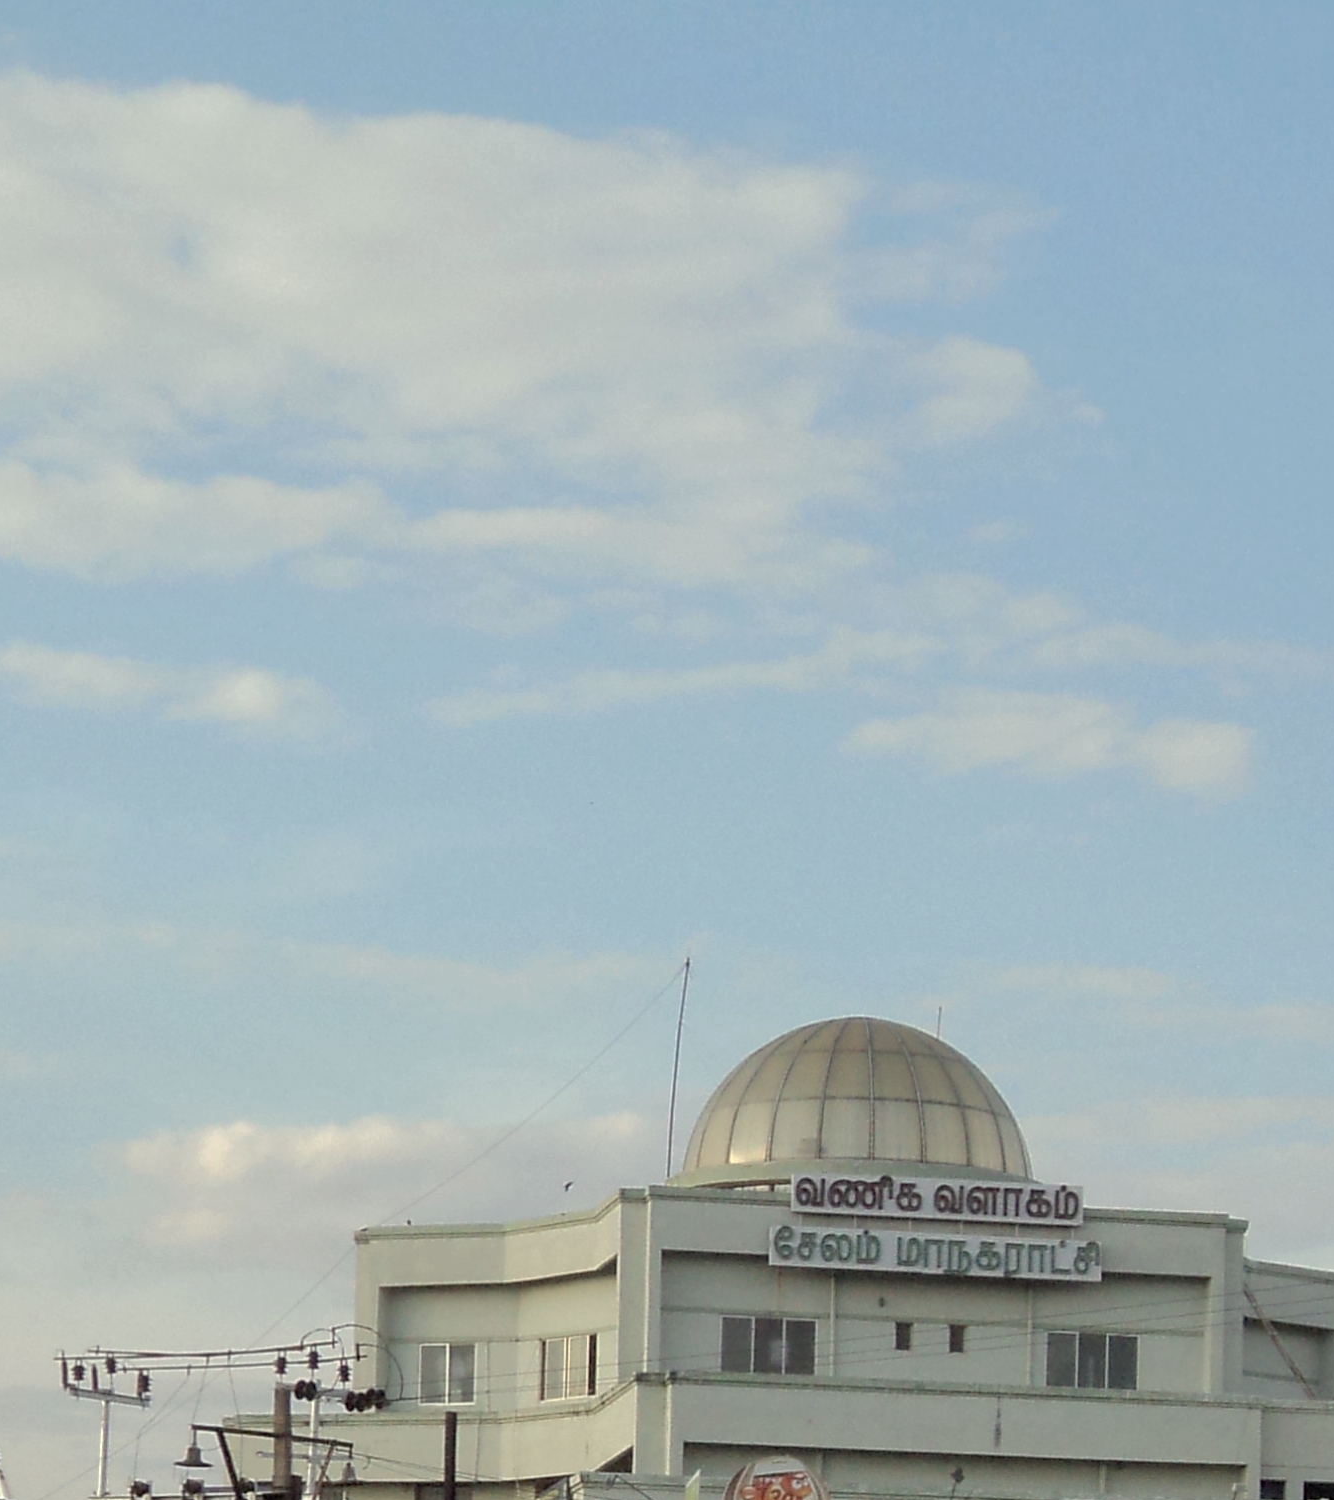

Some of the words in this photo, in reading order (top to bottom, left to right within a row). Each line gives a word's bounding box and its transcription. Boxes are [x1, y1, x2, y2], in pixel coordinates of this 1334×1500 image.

[933, 1184, 1081, 1220] வளாகம்
[773, 1225, 881, 1264] சேலம்
[896, 1236, 1101, 1277] மாநகராட்சி
